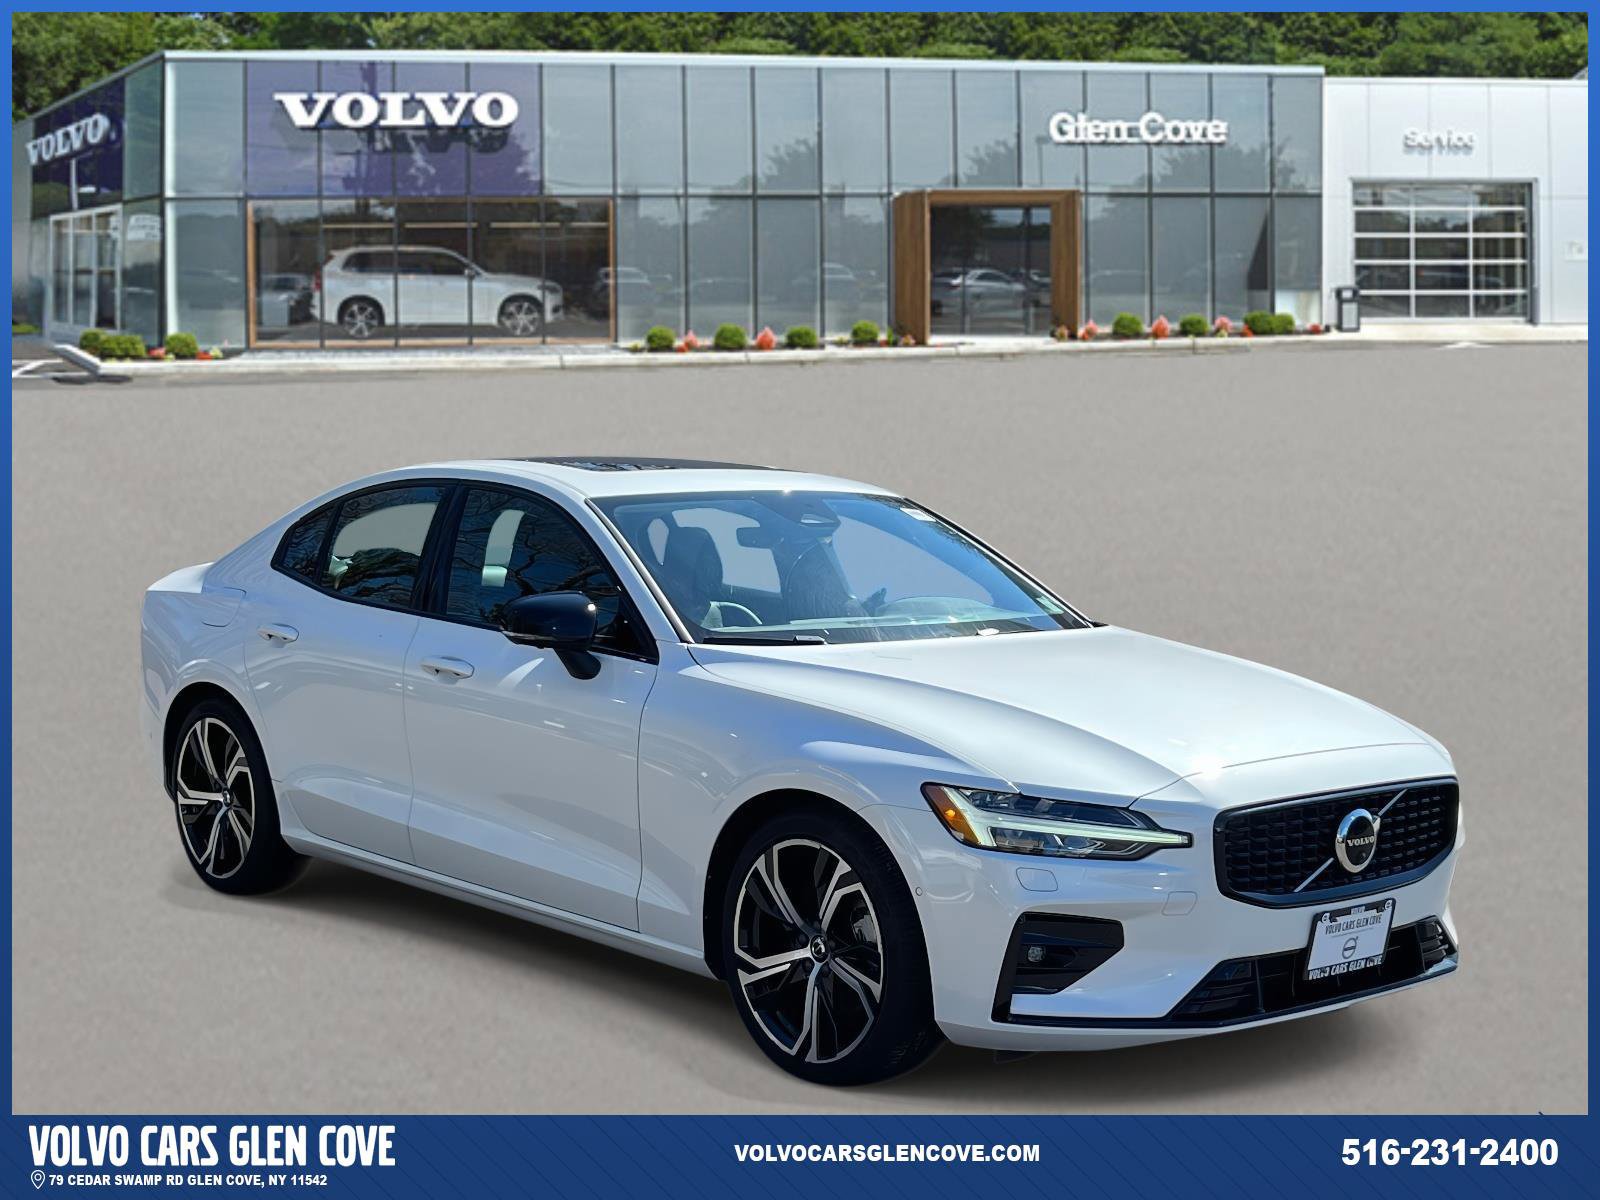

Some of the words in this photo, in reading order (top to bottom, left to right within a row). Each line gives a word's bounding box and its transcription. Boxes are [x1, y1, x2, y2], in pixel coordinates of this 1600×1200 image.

[274, 91, 519, 129] VOLVO
[26, 113, 110, 165] VOLVO
[1048, 111, 1129, 145] Glen
[1139, 111, 1228, 145] Cove
[1402, 127, 1476, 155] Service
[1347, 836, 1375, 847] VOLVO
[1325, 923, 1341, 935] VOLVO
[1341, 919, 1355, 931] CARS
[1356, 916, 1369, 928] GLEN
[1369, 914, 1382, 925] COVE
[1331, 963, 1348, 977] CARS
[1349, 958, 1366, 972] GLEN
